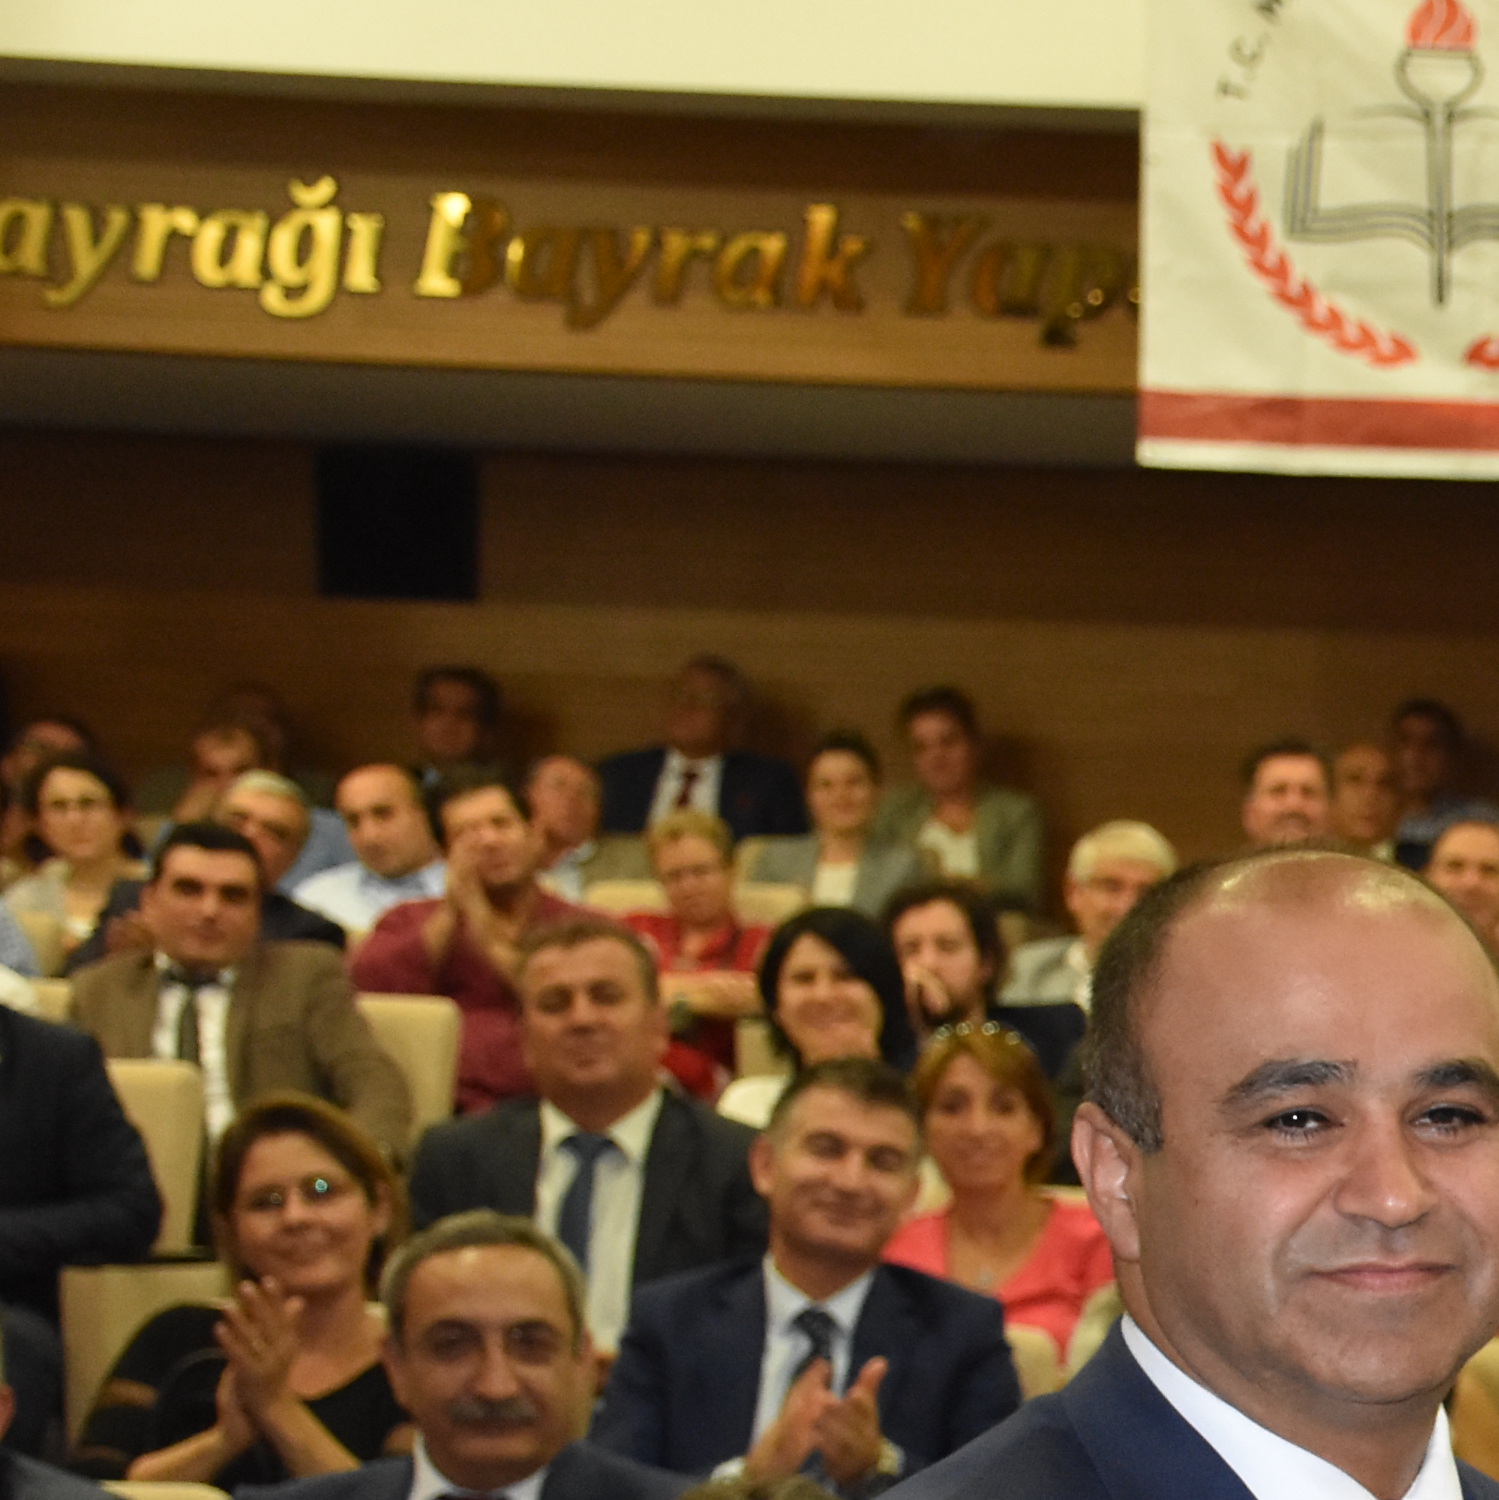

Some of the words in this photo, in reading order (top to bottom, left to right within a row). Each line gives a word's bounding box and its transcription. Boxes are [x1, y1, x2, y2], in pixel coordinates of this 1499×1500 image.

[0, 175, 386, 318] ayrağı
[414, 190, 867, 331] Bayrak
[902, 210, 1139, 353] Yap
